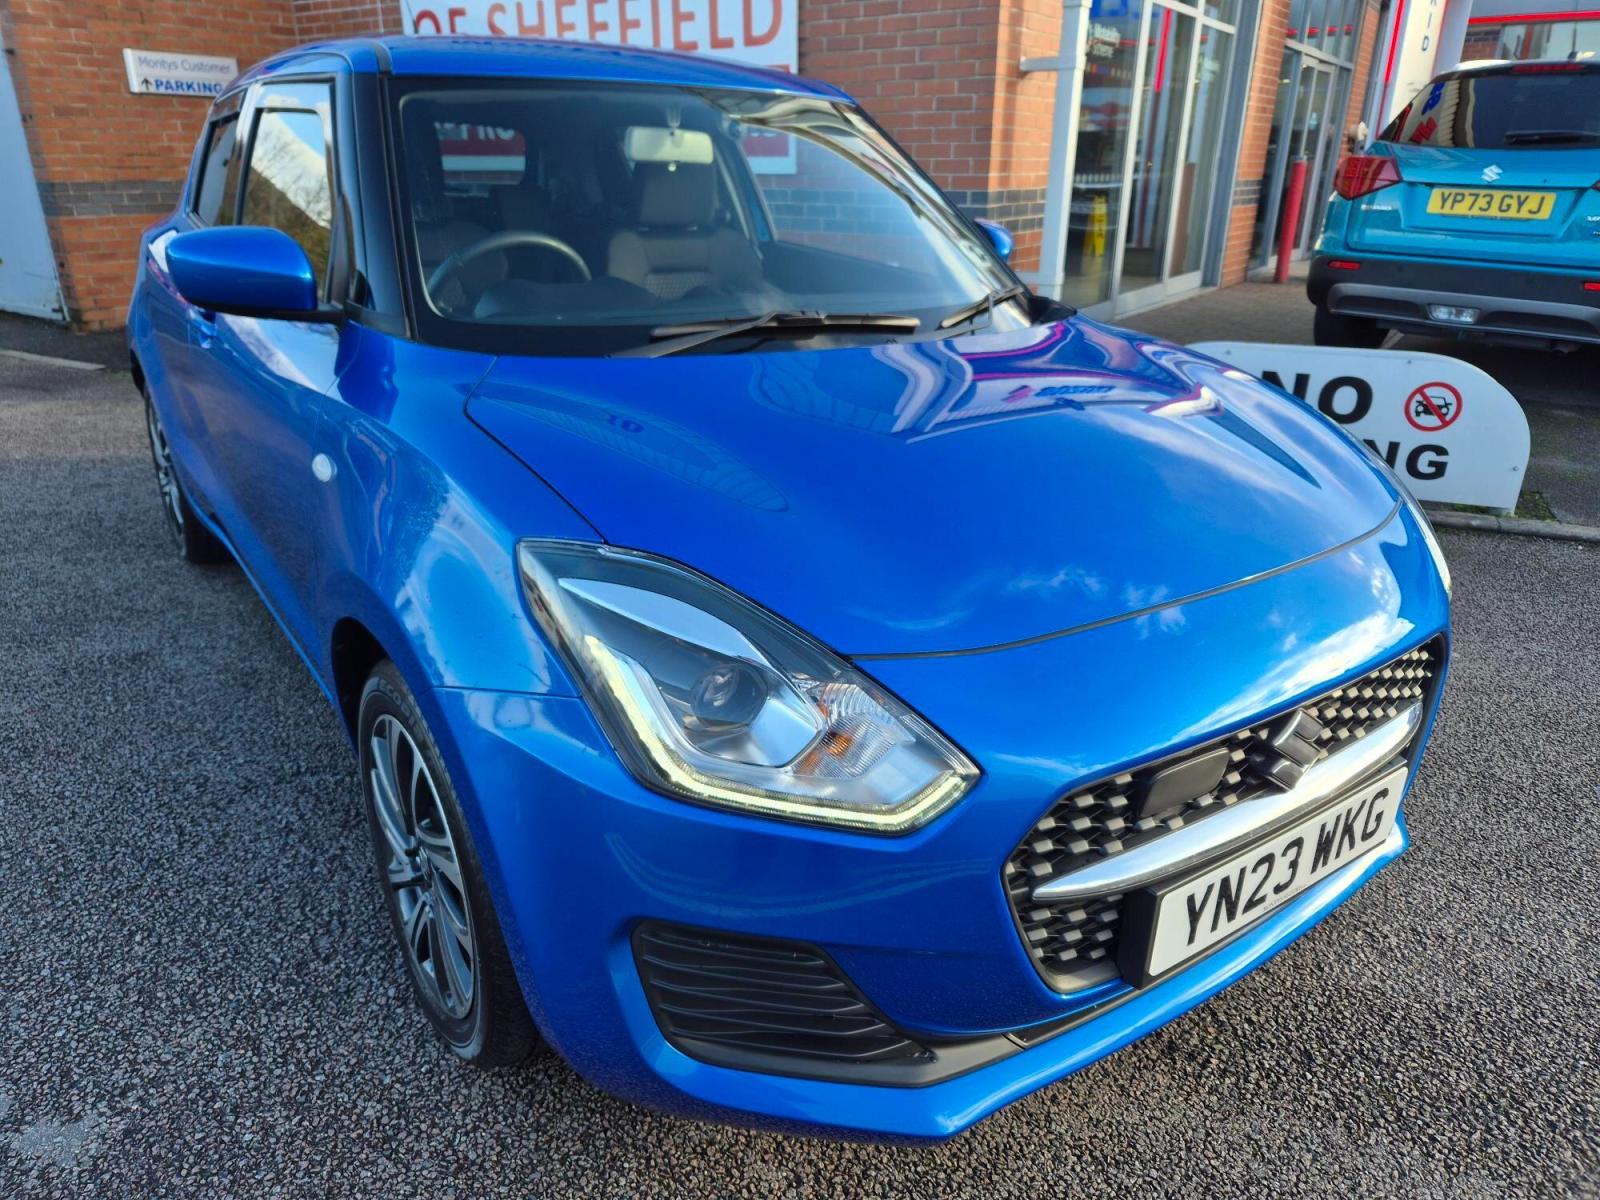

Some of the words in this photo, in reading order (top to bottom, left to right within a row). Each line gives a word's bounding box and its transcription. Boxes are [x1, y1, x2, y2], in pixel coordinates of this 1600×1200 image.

[487, 0, 783, 51] SHEFFIELD
[138, 56, 178, 71] Montys
[180, 59, 230, 73] Customer
[1440, 191, 1494, 212] YP73
[1498, 194, 1545, 215] GYJ
[1261, 370, 1373, 425] NO
[1186, 836, 1305, 947] YN23
[1310, 787, 1390, 876] WKG
